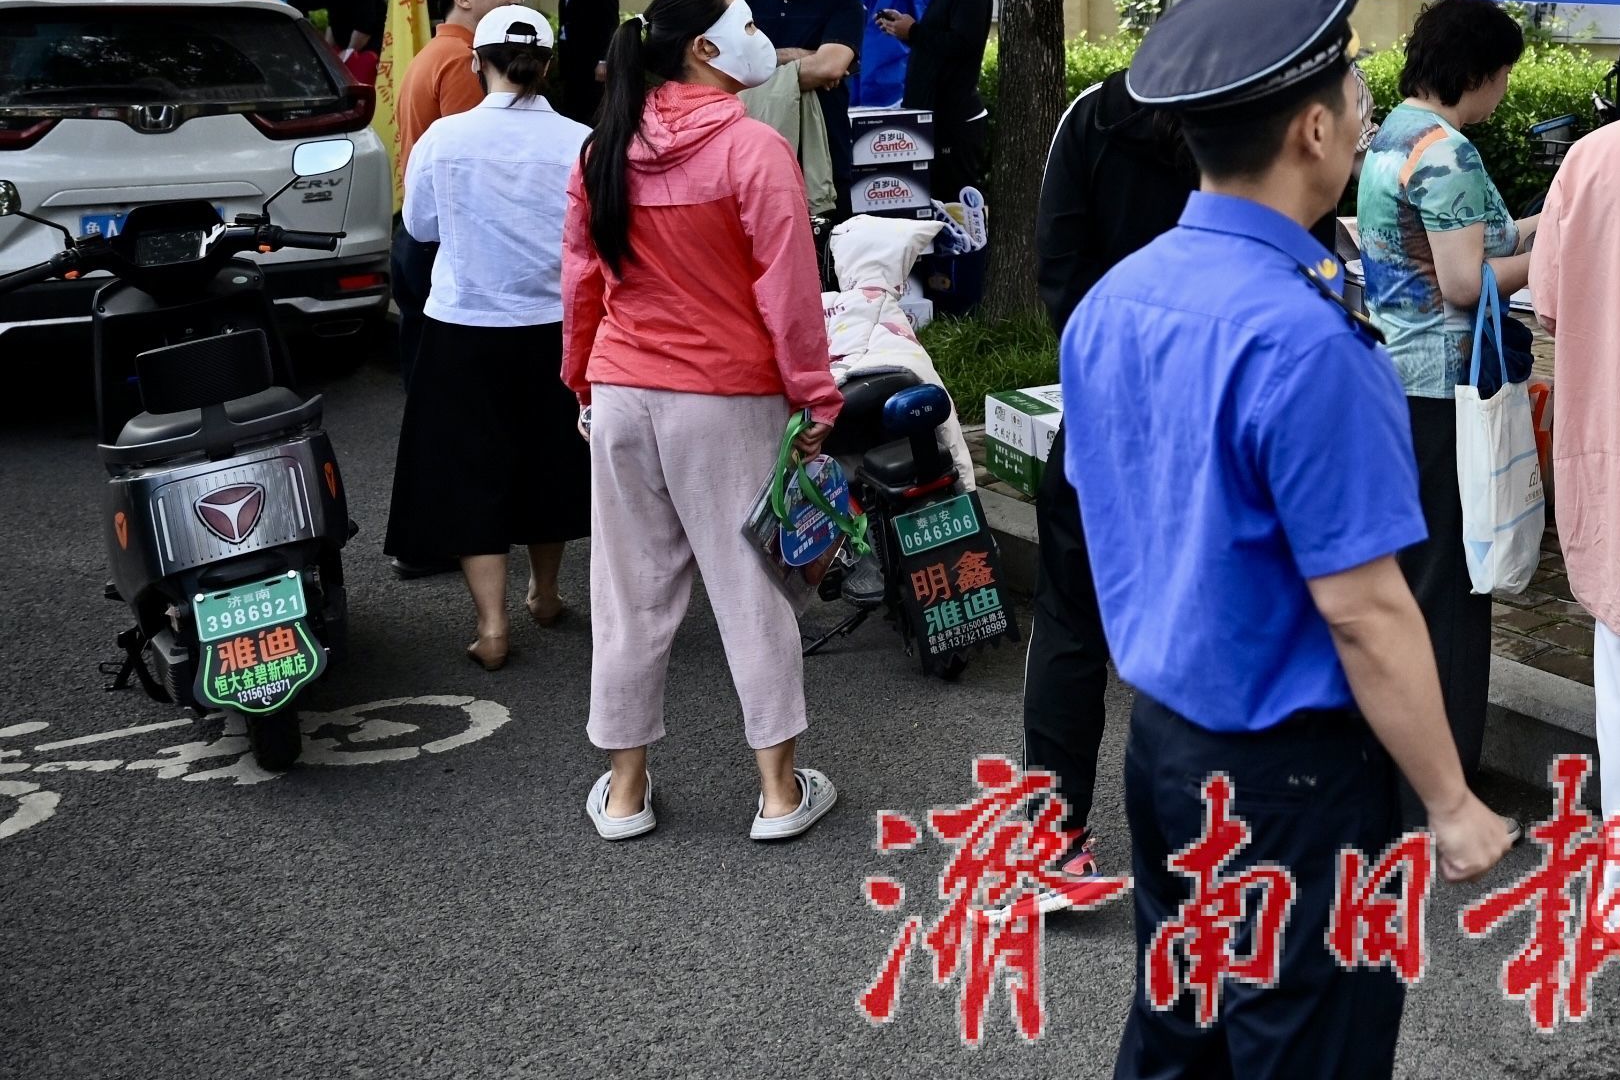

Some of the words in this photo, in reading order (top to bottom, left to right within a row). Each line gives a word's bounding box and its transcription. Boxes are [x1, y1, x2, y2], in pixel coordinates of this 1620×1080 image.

[292, 178, 343, 190] CR-V
[904, 514, 972, 549] 0646306
[916, 509, 951, 530] 泰安
[910, 550, 996, 607] 明鑫
[206, 594, 299, 633] 3986921
[227, 588, 271, 608] 济南
[923, 587, 1003, 636] 雅迪
[217, 627, 299, 675] 雅迪
[214, 653, 308, 698] 恒大金碧新城店
[237, 678, 291, 703] 13156163371
